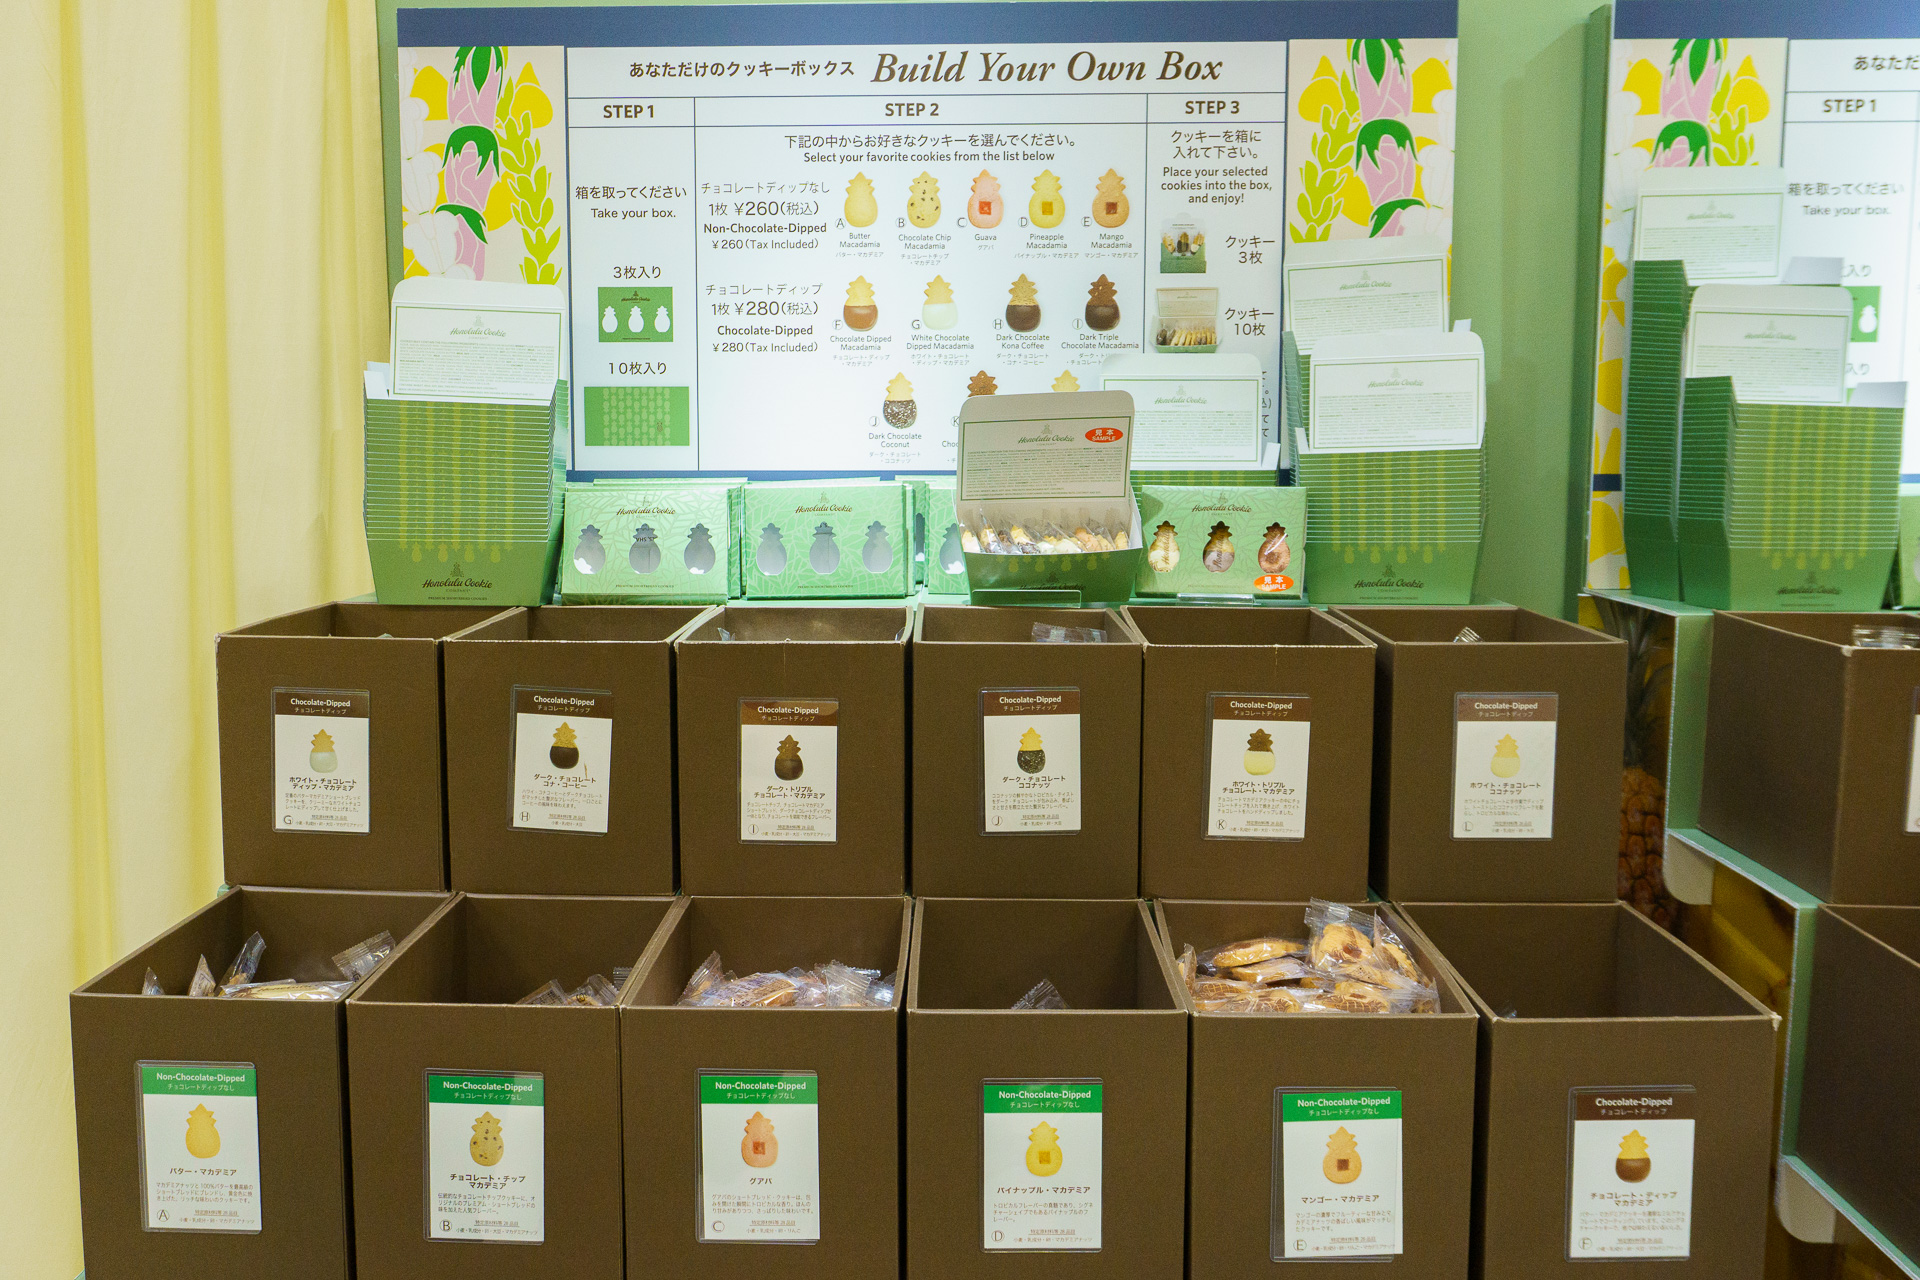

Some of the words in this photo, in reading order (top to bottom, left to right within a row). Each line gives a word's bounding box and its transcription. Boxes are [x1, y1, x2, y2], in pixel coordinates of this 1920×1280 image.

[630, 61, 855, 78] あなただけのクッキーボックス
[870, 50, 968, 83] Build
[979, 52, 1056, 83] Your
[1068, 51, 1146, 82] Own
[1156, 50, 1223, 80] Box
[603, 105, 642, 118] STEP
[647, 105, 654, 118] 1
[885, 103, 925, 117] STEP
[930, 103, 940, 117] 2
[1185, 100, 1226, 114] STEP
[1231, 100, 1240, 114] 3
[1823, 99, 1865, 112] STEP
[1868, 99, 1877, 112] 1
[784, 133, 1076, 148] 下記の中からお好きなクッキーを選んでください。
[1171, 130, 1262, 143] クッキーを箱に
[804, 152, 836, 162] Select
[840, 154, 863, 164] your
[867, 152, 908, 162] favorite
[910, 151, 951, 162] cookies
[954, 150, 979, 162] from
[982, 150, 1000, 161] the
[1003, 150, 1020, 161] list
[1023, 150, 1054, 161] below
[1173, 146, 1258, 159] 入れて下さい。
[1164, 166, 1192, 176] Place
[1195, 168, 1219, 178] your
[1222, 166, 1268, 176] selected
[701, 182, 830, 194] チョコレートディップなし
[1161, 180, 1202, 190] cookies
[1206, 180, 1226, 190] into
[1229, 180, 1246, 190] the
[1250, 180, 1272, 191] box,
[575, 186, 687, 200] 箱を取ってください
[1188, 193, 1208, 203] and
[1212, 193, 1244, 205] enjoy!
[591, 208, 618, 218] Take
[622, 210, 648, 220] your
[652, 208, 676, 218] box.
[708, 202, 728, 216] 1枚
[1802, 206, 1830, 215] Take
[1834, 206, 1862, 217] your
[704, 223, 827, 235] Non-Chocolate-Dipped
[770, 238, 820, 250] Included)
[935, 234, 951, 242] Chip
[1225, 236, 1275, 249] クッキー
[1238, 251, 1263, 264] 3枚
[613, 266, 662, 279] 3枚入り
[706, 284, 823, 296] チョコレートディップ
[712, 303, 730, 316] 1枚
[1224, 308, 1274, 321] クッキー
[450, 328, 483, 336] Honolulu
[484, 328, 506, 337] Cookie
[717, 325, 813, 337] Chocolate-Dipped
[1235, 324, 1265, 336] 10枚
[770, 342, 818, 353] Included)
[608, 362, 667, 375] 10枚入り
[1018, 435, 1050, 444] Honolulu
[616, 506, 650, 515] Honolulu
[795, 504, 828, 513] Honolulu
[830, 504, 852, 512] Cookie
[1192, 504, 1226, 512] Honolulu
[1227, 504, 1252, 512] Cookie
[422, 578, 462, 588] Honolulu
[464, 578, 492, 588] Cookie
[1354, 579, 1394, 588] Honolulu
[1396, 579, 1424, 588] Cookie
[291, 698, 350, 707] Chocolate-Dipped
[534, 696, 594, 706] Chocolate-Dipped
[1230, 701, 1292, 709] Chocolate-Dipped
[157, 1073, 245, 1082] Non-Chocolate-Dipped
[443, 1082, 532, 1092] Non-Chocolate-Dipped
[716, 1082, 806, 1090] Non-Chocolate-Dipped
[999, 1091, 1091, 1099] Non-Chocolate-Dipped
[1298, 1097, 1390, 1107] Non-Chocolate-Dipped
[1596, 1097, 1672, 1106] Chocolate-Dipped
[170, 1168, 236, 1176] バター・マカデミア
[450, 1174, 525, 1183] チョコレート・チップ
[1301, 1195, 1379, 1204] マンゴー・マカデミア
